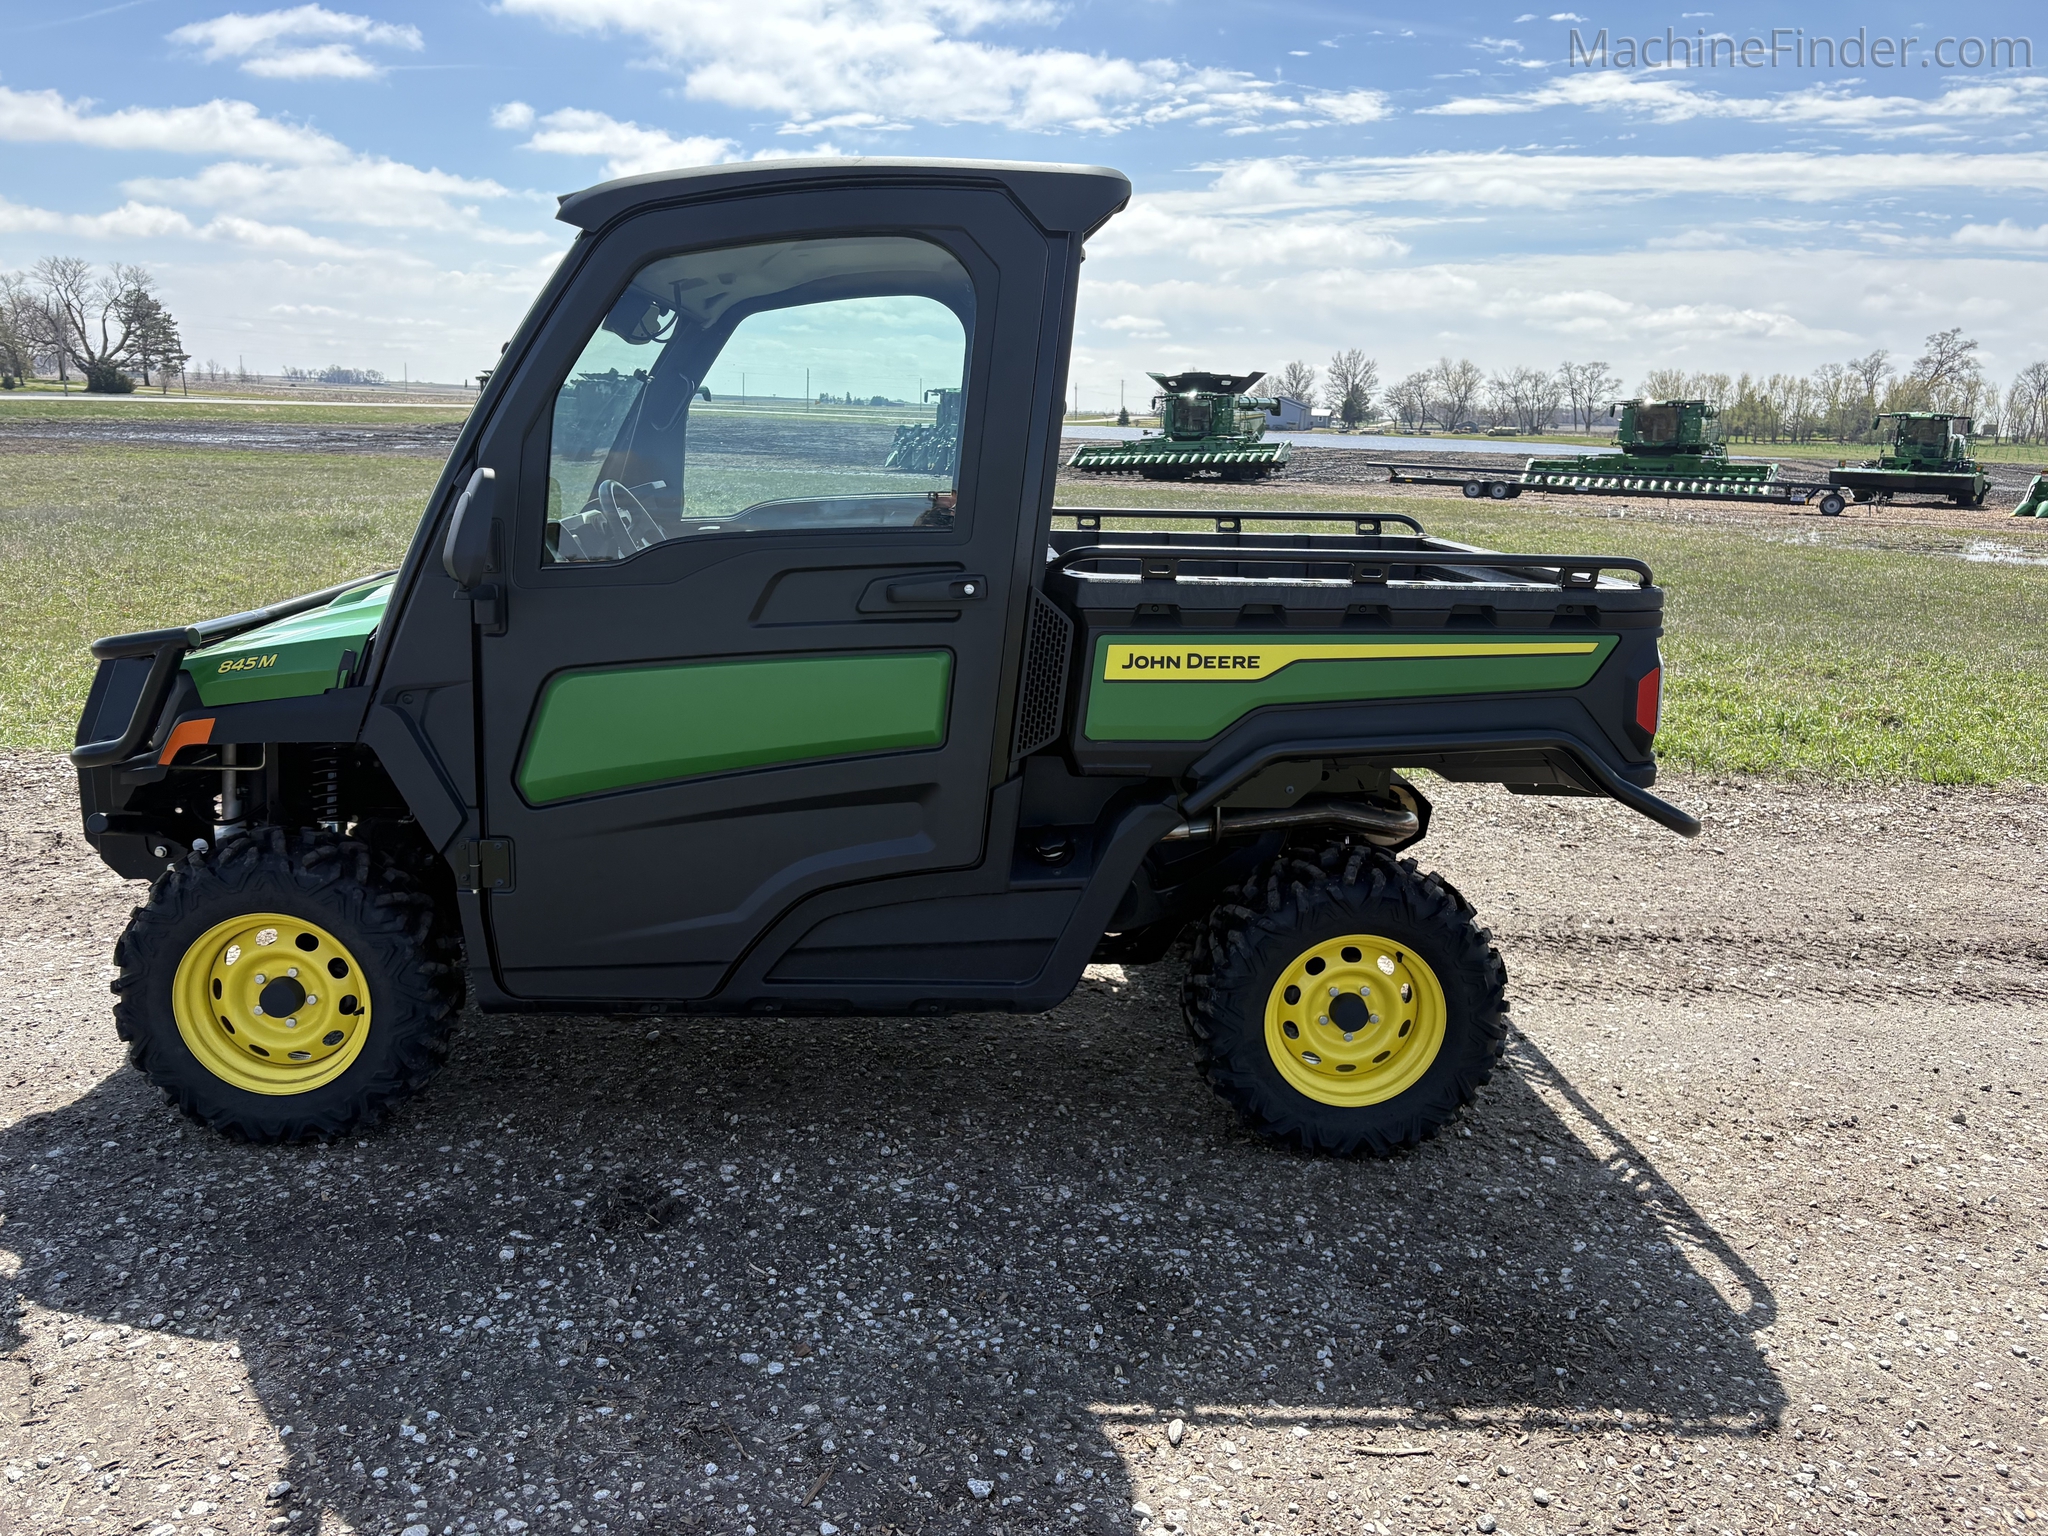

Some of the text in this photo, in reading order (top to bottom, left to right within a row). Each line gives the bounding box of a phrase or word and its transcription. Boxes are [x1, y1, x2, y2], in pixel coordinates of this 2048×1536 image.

[217, 653, 278, 674] 845M
[1121, 653, 1261, 669] JOHN DEERE
